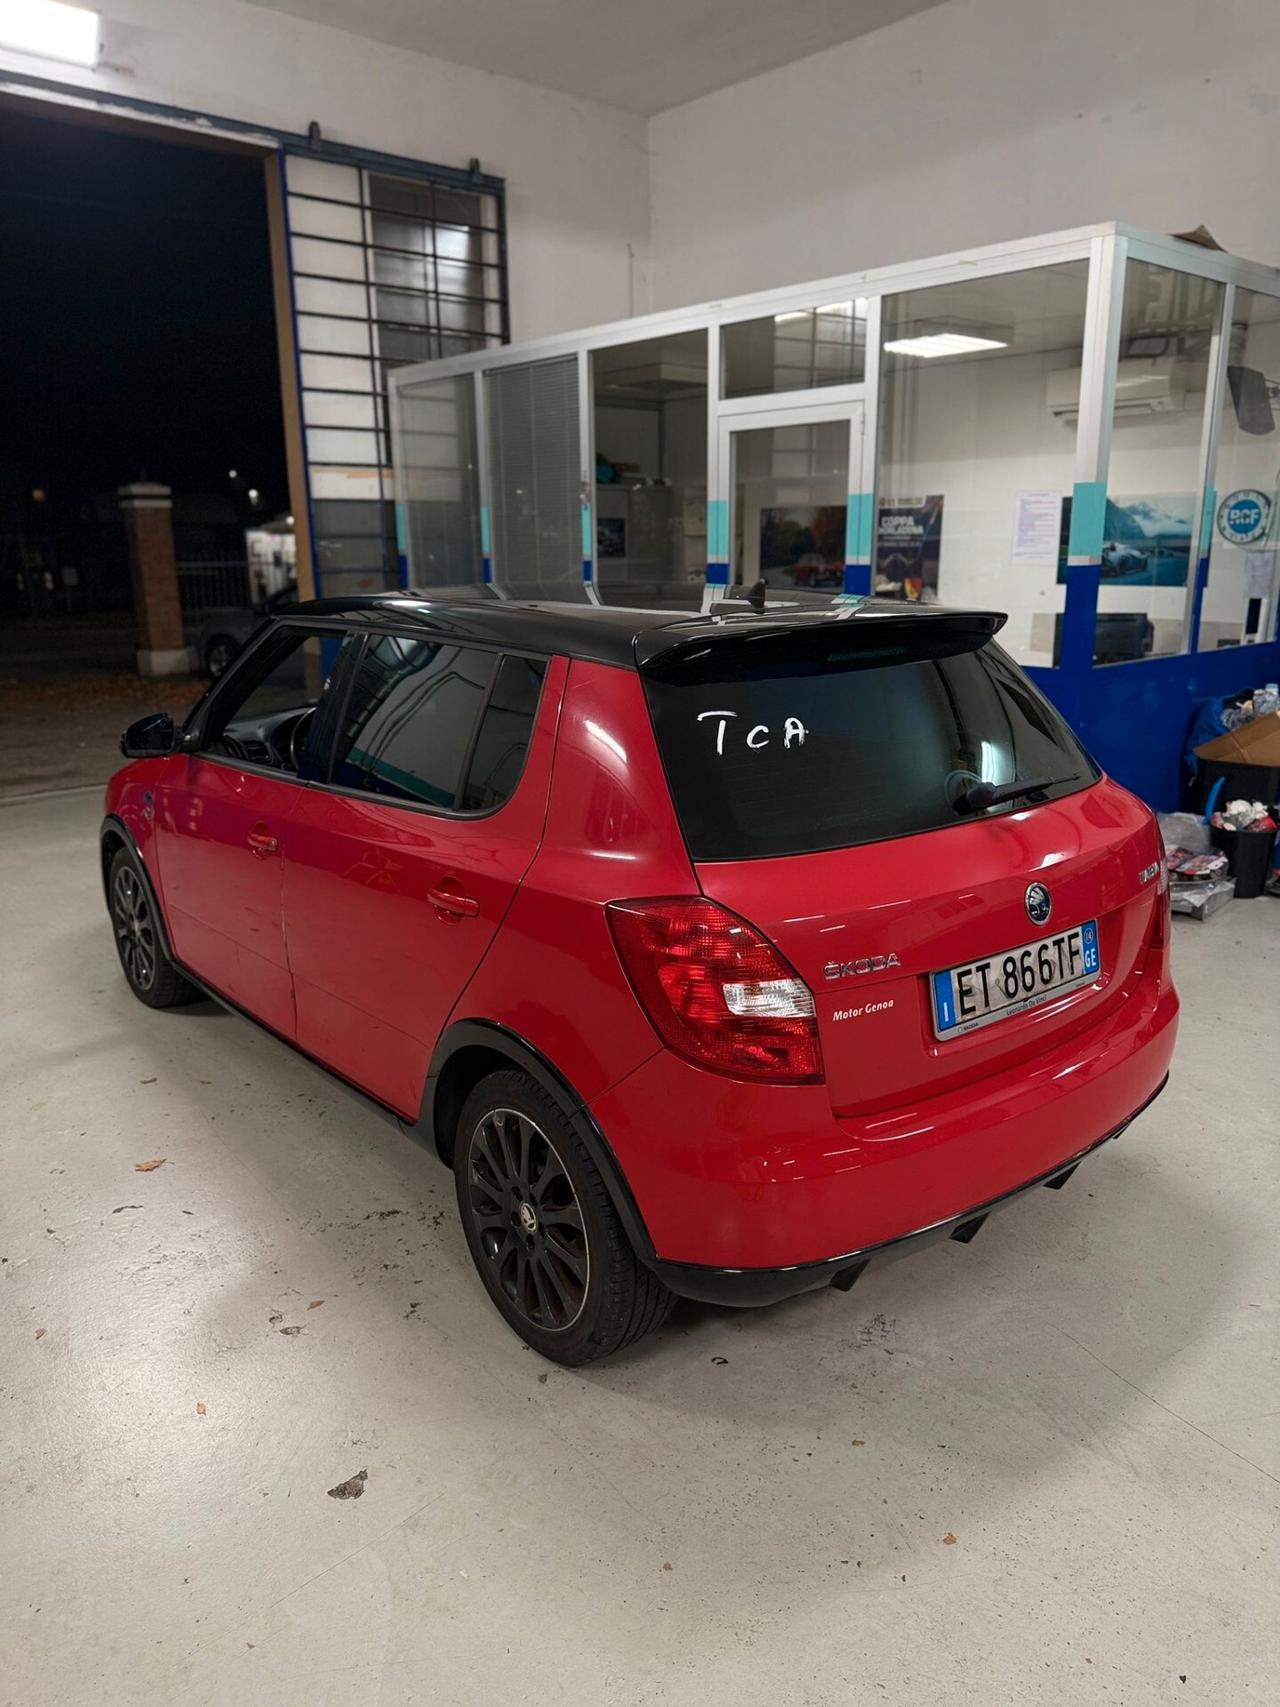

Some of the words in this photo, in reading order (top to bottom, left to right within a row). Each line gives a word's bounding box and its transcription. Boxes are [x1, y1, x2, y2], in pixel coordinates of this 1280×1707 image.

[824, 952, 901, 980] ŠKODA
[1084, 948, 1097, 968] GE
[957, 962, 991, 1016] ET
[1003, 931, 1080, 999] 866TF
[832, 1007, 863, 1022] Motor
[865, 999, 894, 1013] Genoa
[943, 1002, 949, 1022] I
